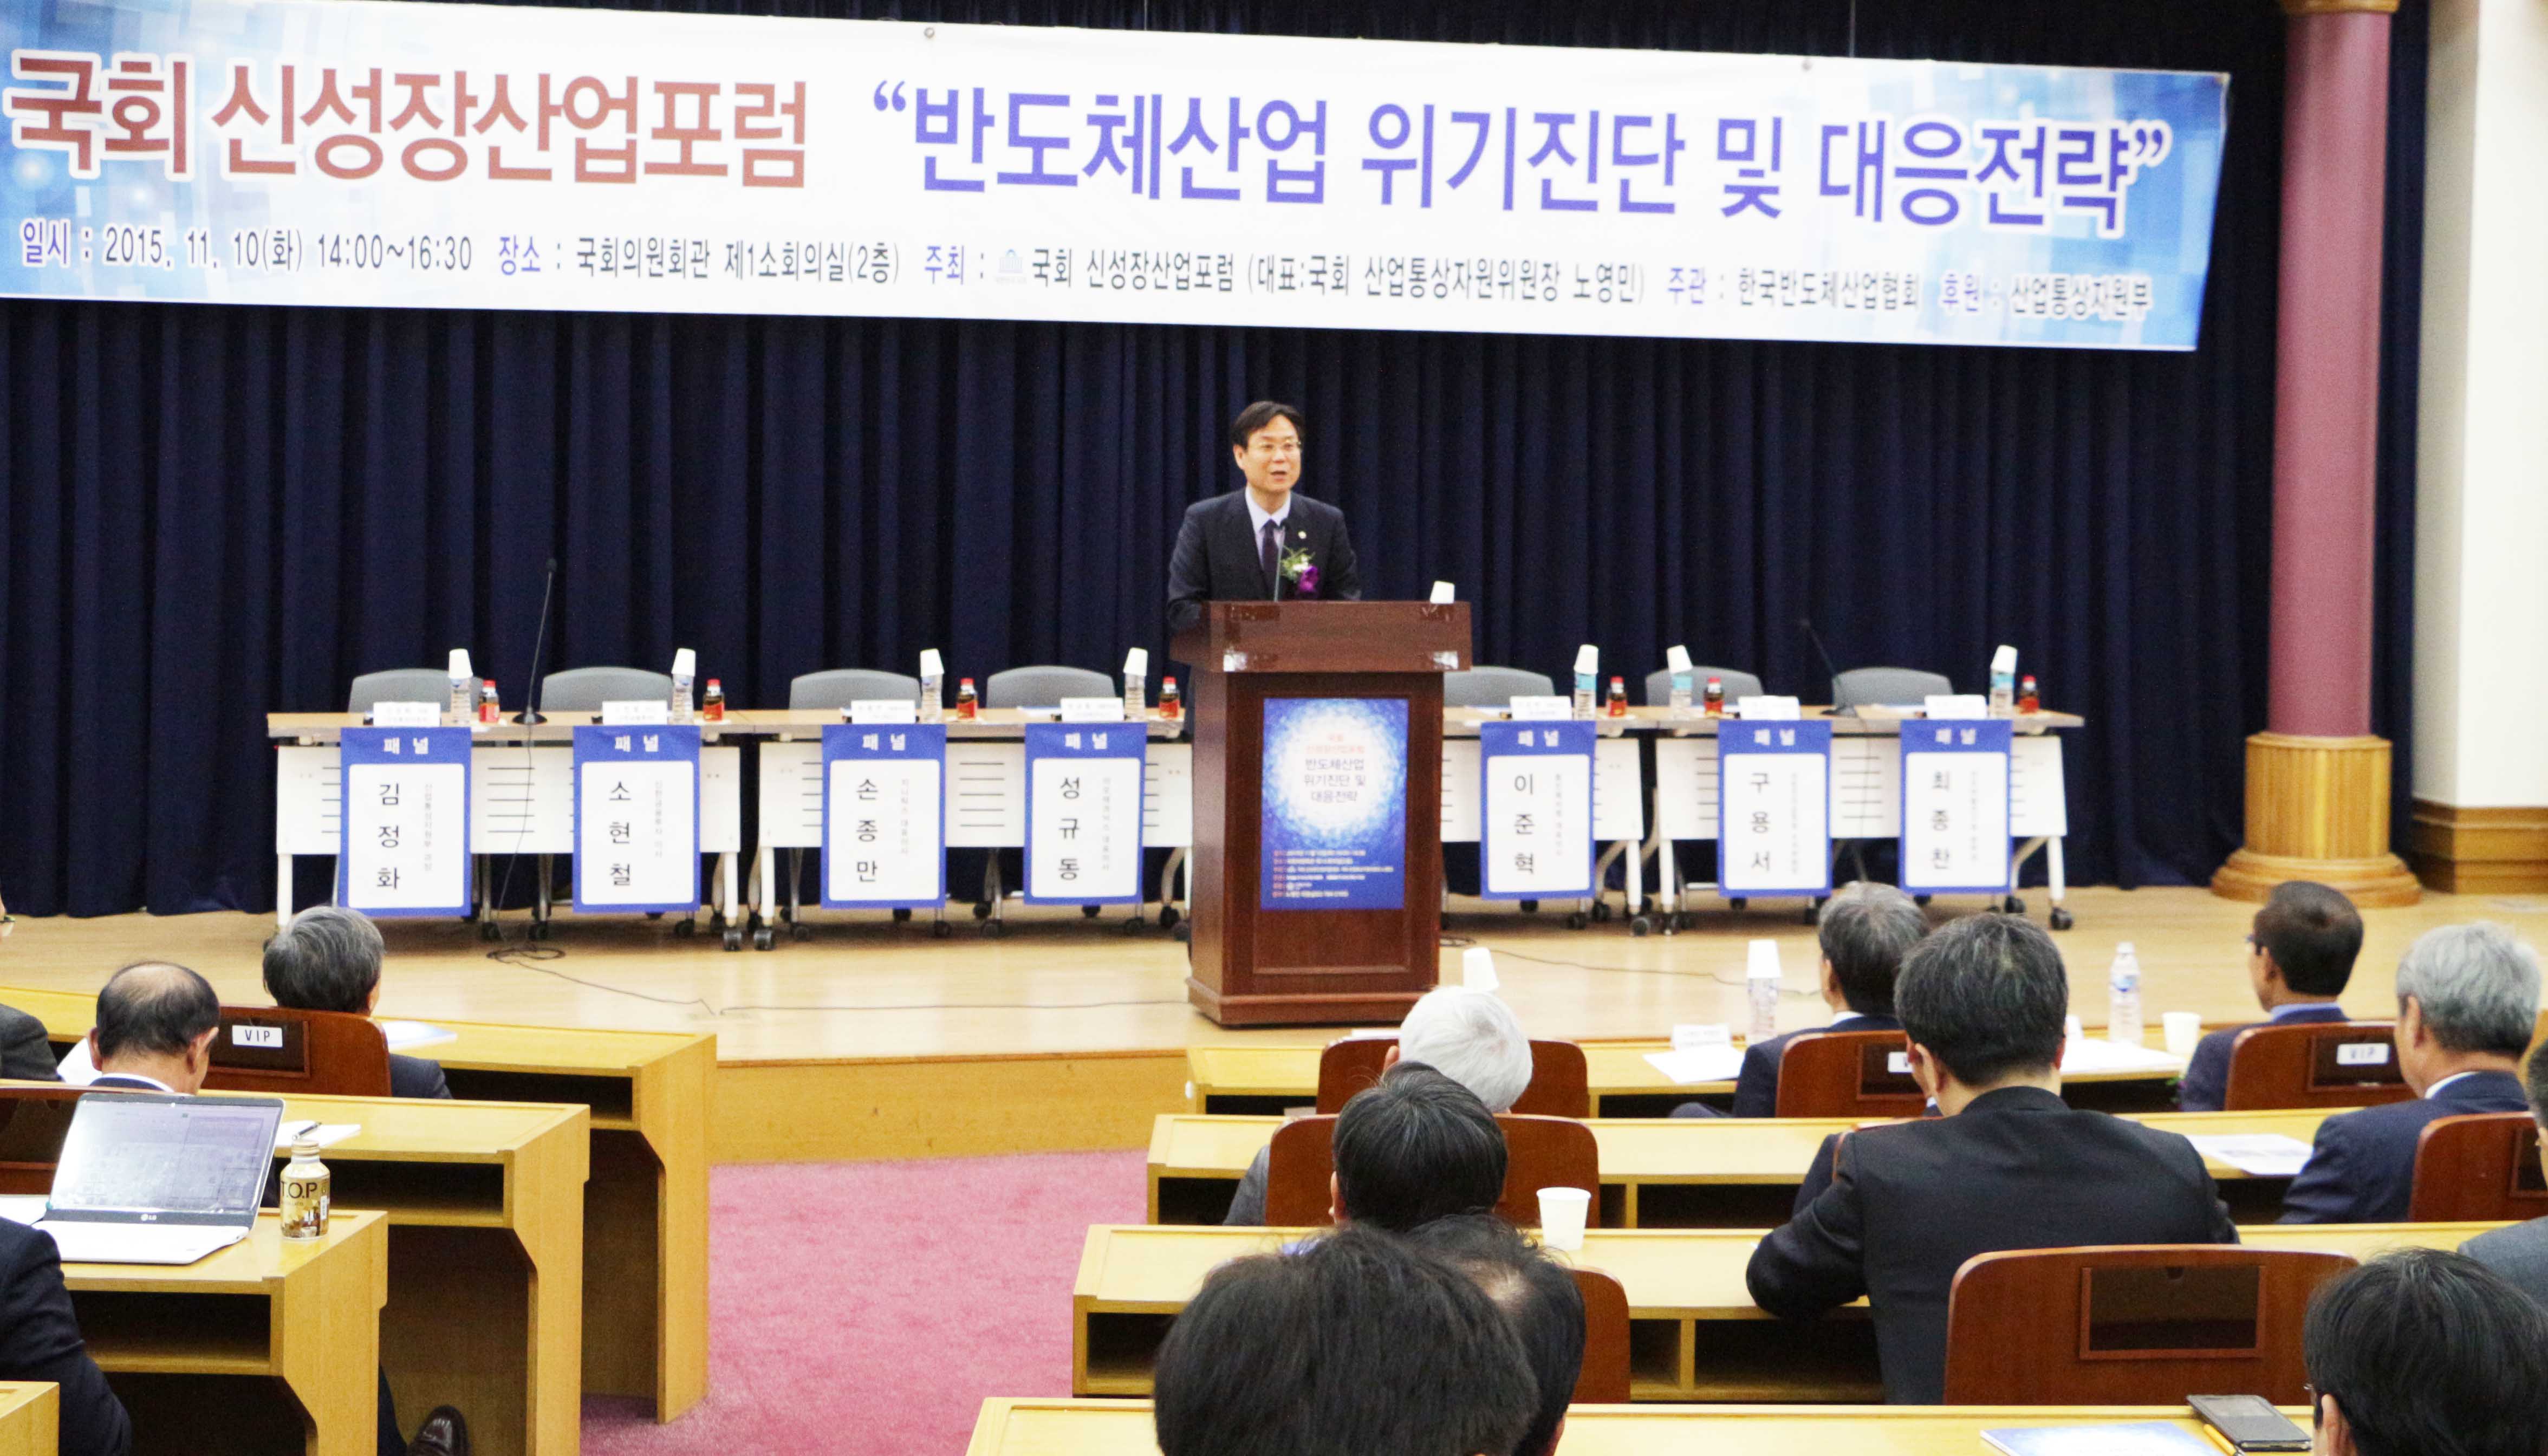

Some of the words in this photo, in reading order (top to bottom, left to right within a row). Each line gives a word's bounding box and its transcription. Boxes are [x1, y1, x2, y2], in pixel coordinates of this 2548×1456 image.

[11, 57, 187, 173] 국회
[211, 64, 807, 189] 신성장산업포럼
[1362, 103, 1686, 216] 위기진단
[1717, 116, 1783, 219] 및
[23, 222, 69, 265] 일시
[234, 229, 302, 271] 10(화)
[318, 233, 472, 270] 14:00~16:30
[499, 235, 542, 276] 장소
[577, 237, 711, 280] 국회의원회관
[725, 240, 899, 285] 제1소회의실(2층)
[925, 245, 964, 285] 주최
[1032, 249, 1072, 288] 국회
[1087, 250, 1234, 293] 신성장산업포럼
[1365, 257, 1561, 302] 산업통상자원위원장
[1573, 262, 1644, 305] 노영민)
[1668, 266, 1707, 306] 주관
[1740, 268, 1919, 311] 한국반도체산업협회
[1943, 273, 1978, 312] 후원
[2012, 277, 2148, 316] 산업통상자원부
[1305, 758, 1364, 771] 반도체산업
[245, 1029, 270, 1042] VIP
[281, 1181, 318, 1199] T.O.P
